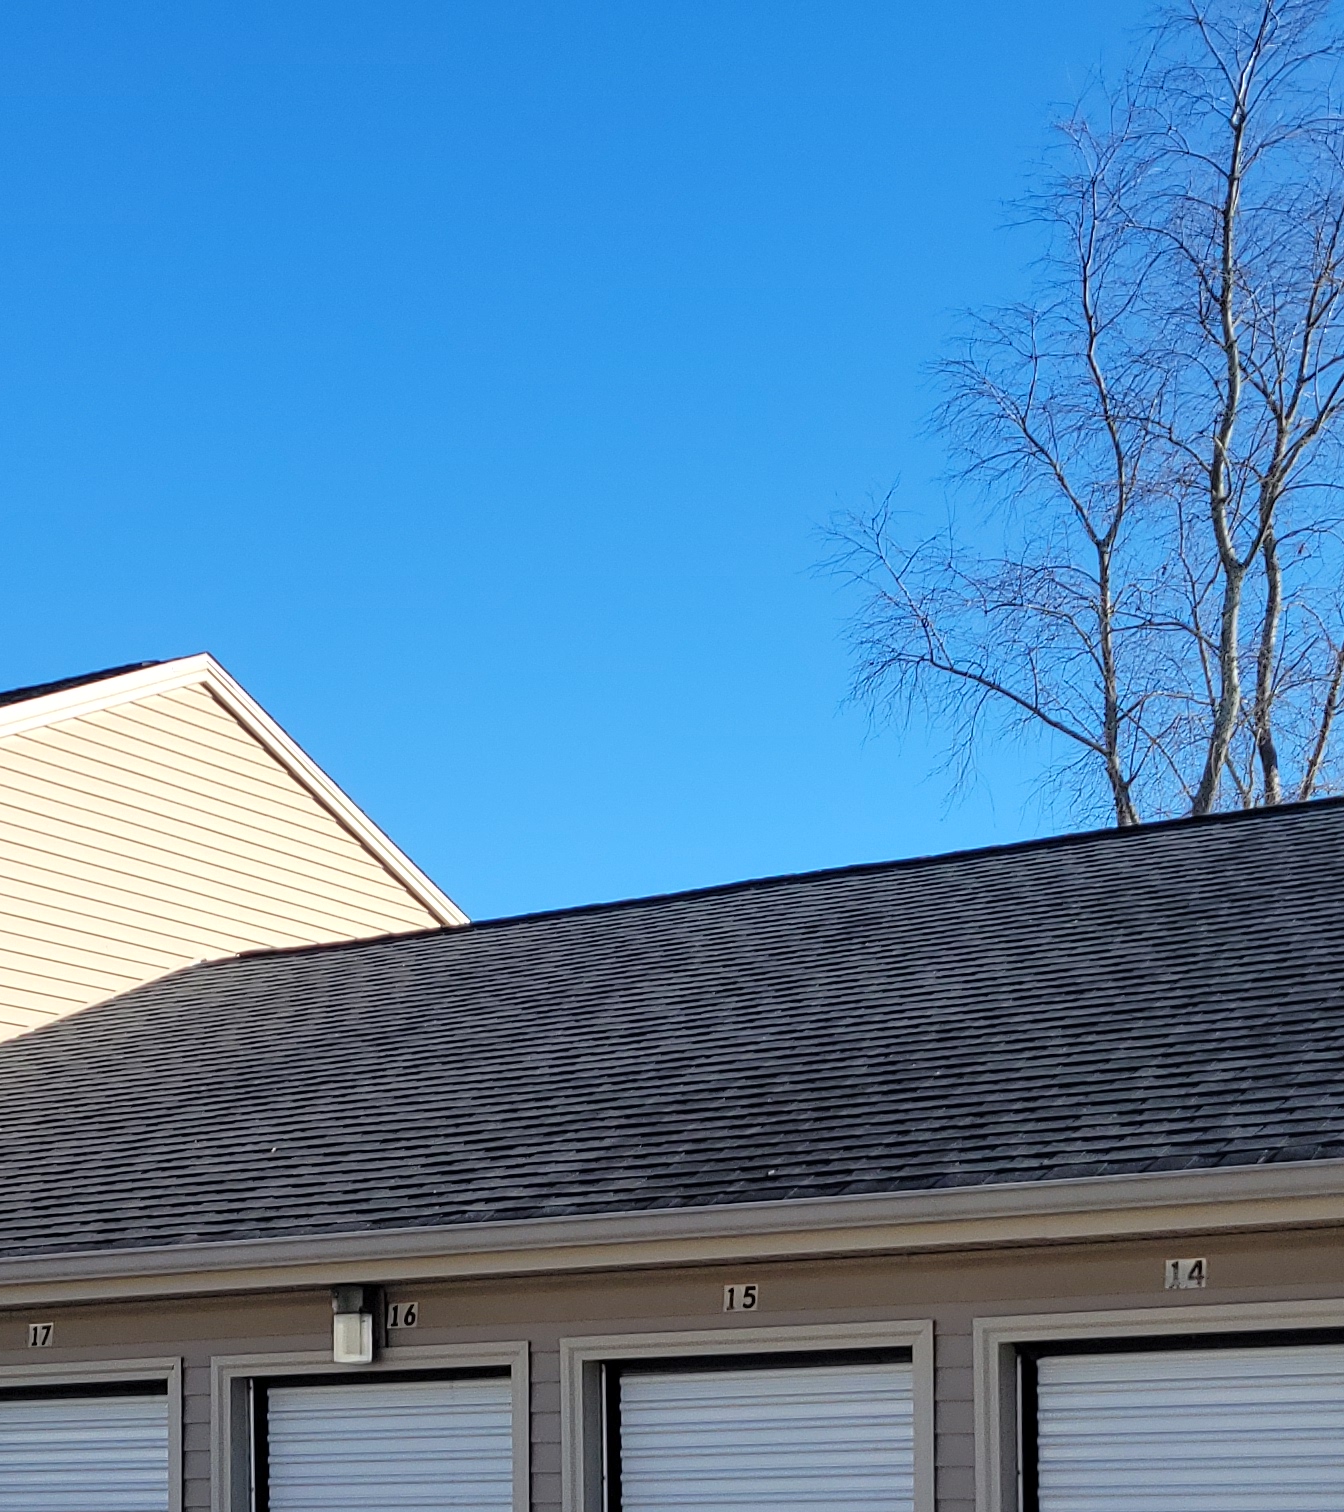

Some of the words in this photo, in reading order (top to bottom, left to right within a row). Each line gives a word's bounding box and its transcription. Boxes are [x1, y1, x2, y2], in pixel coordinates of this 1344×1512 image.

[1171, 1259, 1205, 1286] 14
[726, 1286, 757, 1310] 15
[390, 1304, 416, 1327] 16
[31, 1325, 52, 1346] 17
